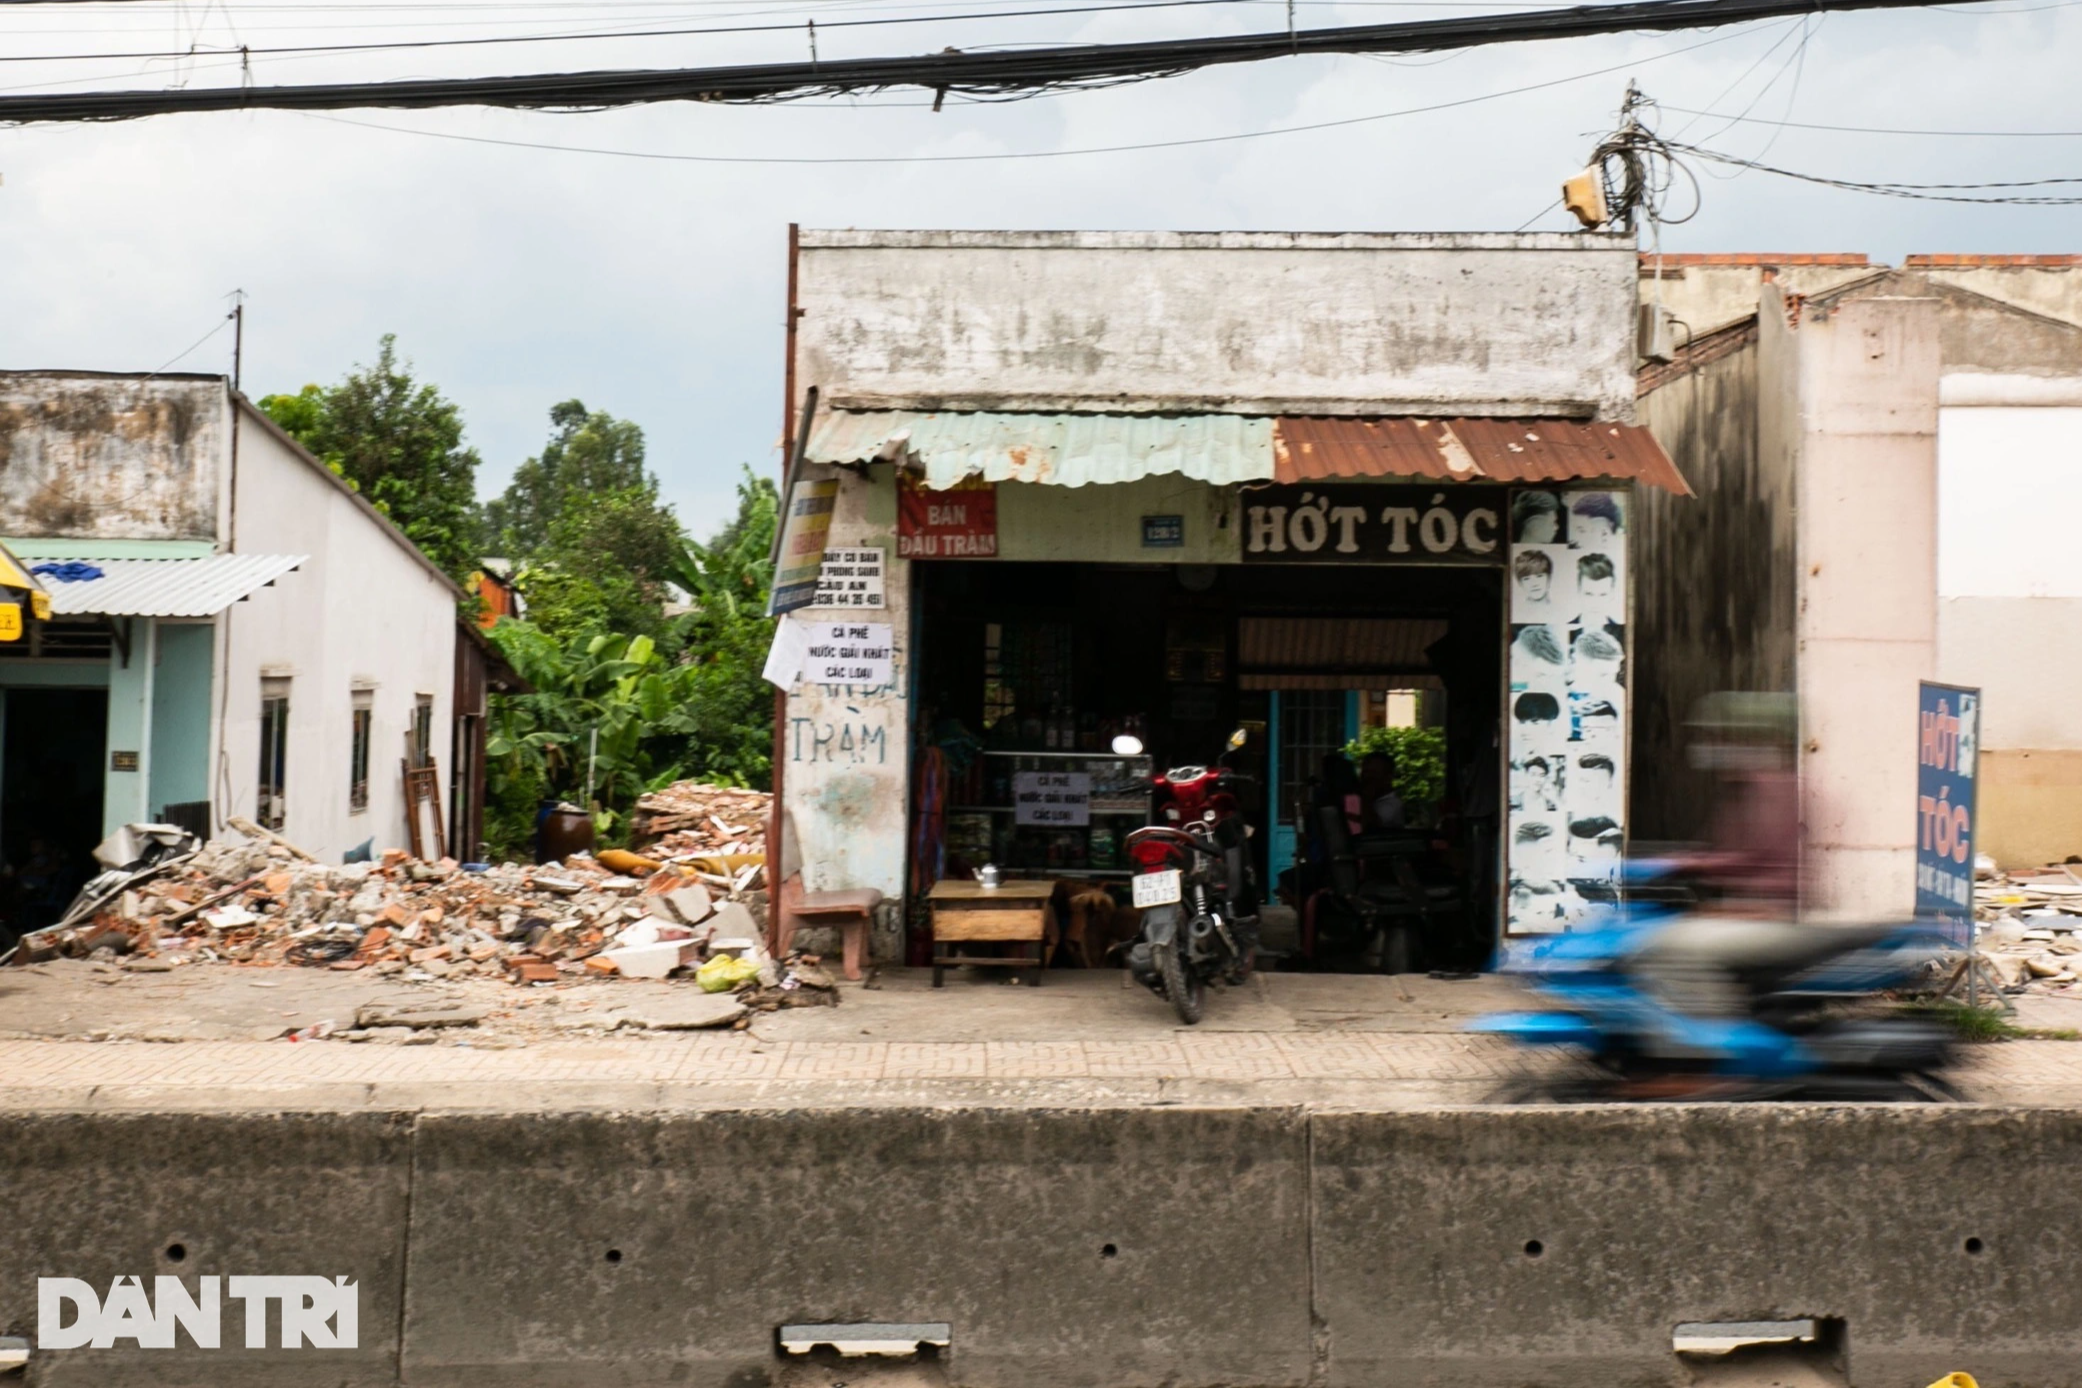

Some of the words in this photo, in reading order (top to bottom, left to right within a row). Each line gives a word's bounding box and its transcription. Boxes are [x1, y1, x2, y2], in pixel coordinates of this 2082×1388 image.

[927, 499, 967, 526] BÁN
[1247, 491, 1367, 553] HỚT
[1381, 492, 1498, 554] TÓC
[1918, 785, 1970, 864] TÓC
